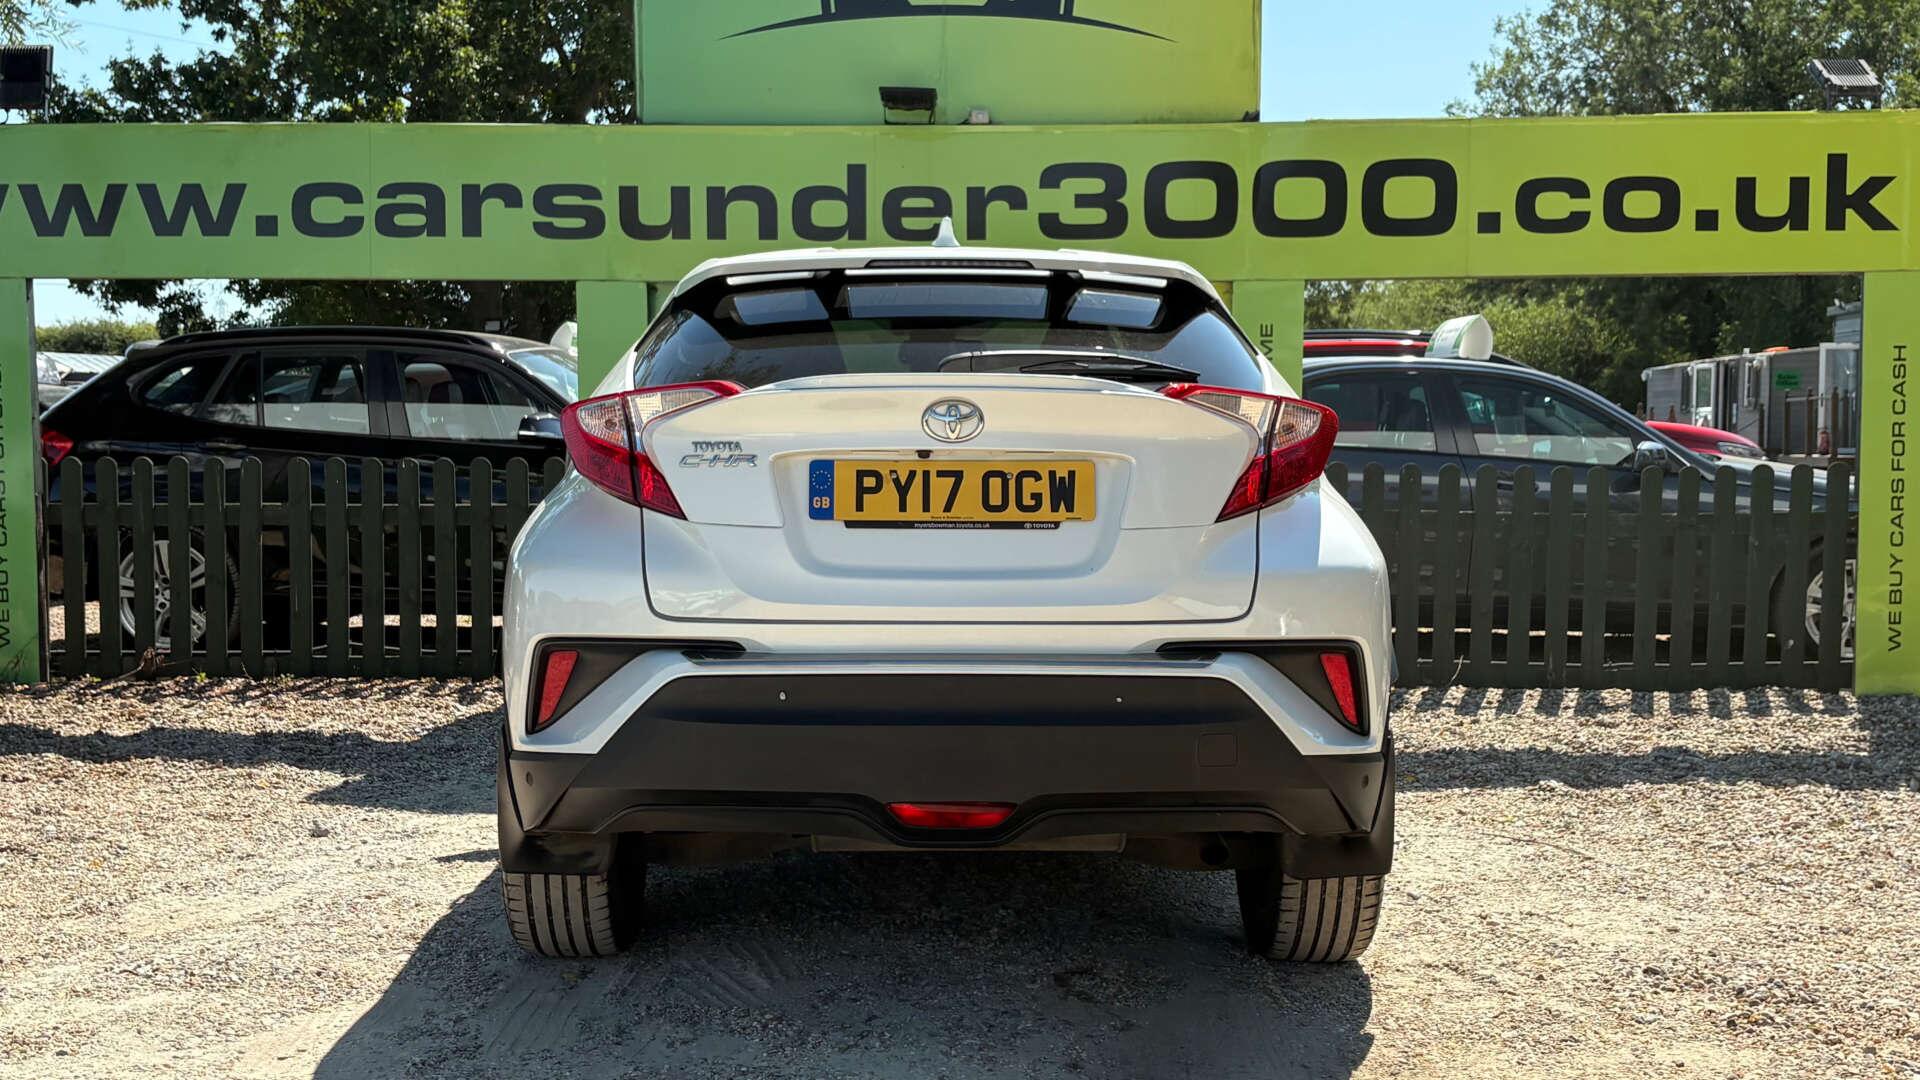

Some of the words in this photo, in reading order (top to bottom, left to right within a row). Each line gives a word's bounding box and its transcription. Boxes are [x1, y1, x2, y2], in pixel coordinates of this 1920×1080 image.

[0, 153, 1899, 241] ww.carsunder3000.co.uk
[1892, 344, 1908, 415] CASH
[679, 454, 757, 468] C-HR
[692, 441, 743, 453] TOYOTA
[1891, 421, 1905, 473] FOR
[812, 496, 831, 509] GB
[855, 469, 964, 513] PY17
[981, 469, 1076, 513] OGW
[1890, 477, 1905, 547] CARS
[1031, 521, 1056, 530] TOYOTA
[1889, 553, 1904, 603] BUY
[1888, 612, 1902, 651] WE
